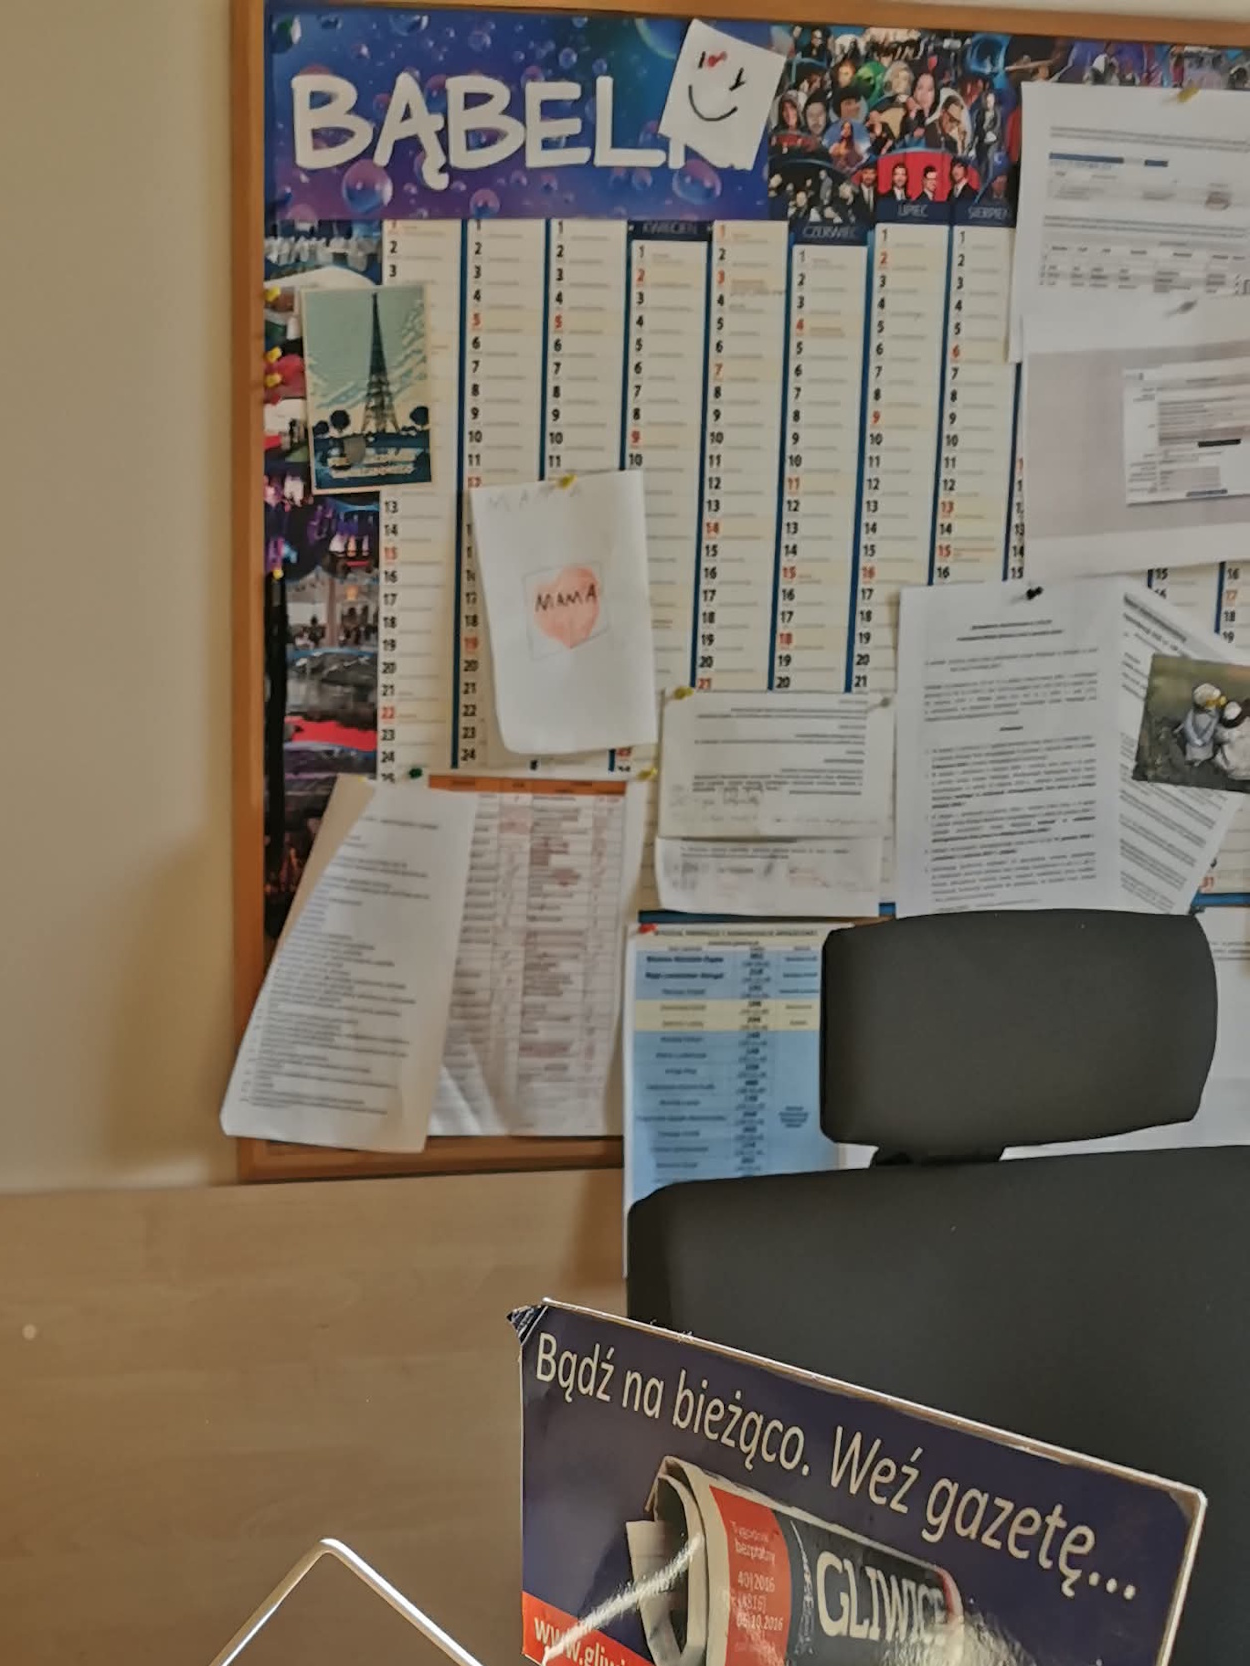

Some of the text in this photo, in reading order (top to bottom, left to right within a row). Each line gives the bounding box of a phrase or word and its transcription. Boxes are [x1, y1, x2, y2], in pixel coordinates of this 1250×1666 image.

[389, 239, 398, 254] 2
[556, 244, 565, 259] 2
[473, 264, 482, 280] 3
[636, 291, 645, 306] 3
[876, 319, 885, 334] 5
[954, 321, 962, 336] 5
[715, 339, 724, 354] 6
[796, 340, 804, 356] 5
[470, 406, 480, 420] 9
[551, 408, 561, 422] 9
[791, 431, 800, 446] 9
[869, 432, 883, 446] 10
[628, 452, 643, 467] 10
[944, 456, 956, 469] 11
[708, 476, 722, 490] 12
[939, 522, 953, 535] 14
[784, 543, 798, 556] 14
[863, 544, 876, 558] 15
[383, 569, 398, 584] 16
[703, 566, 718, 580] 16
[858, 631, 872, 645] 19
[381, 661, 397, 675] 20
[698, 655, 714, 669] 20
[775, 676, 791, 689] 20
[462, 704, 477, 717] 22
[380, 750, 395, 764] 24
[536, 1332, 1138, 1601] Bądź na bieżąco. Weź gazetę...
